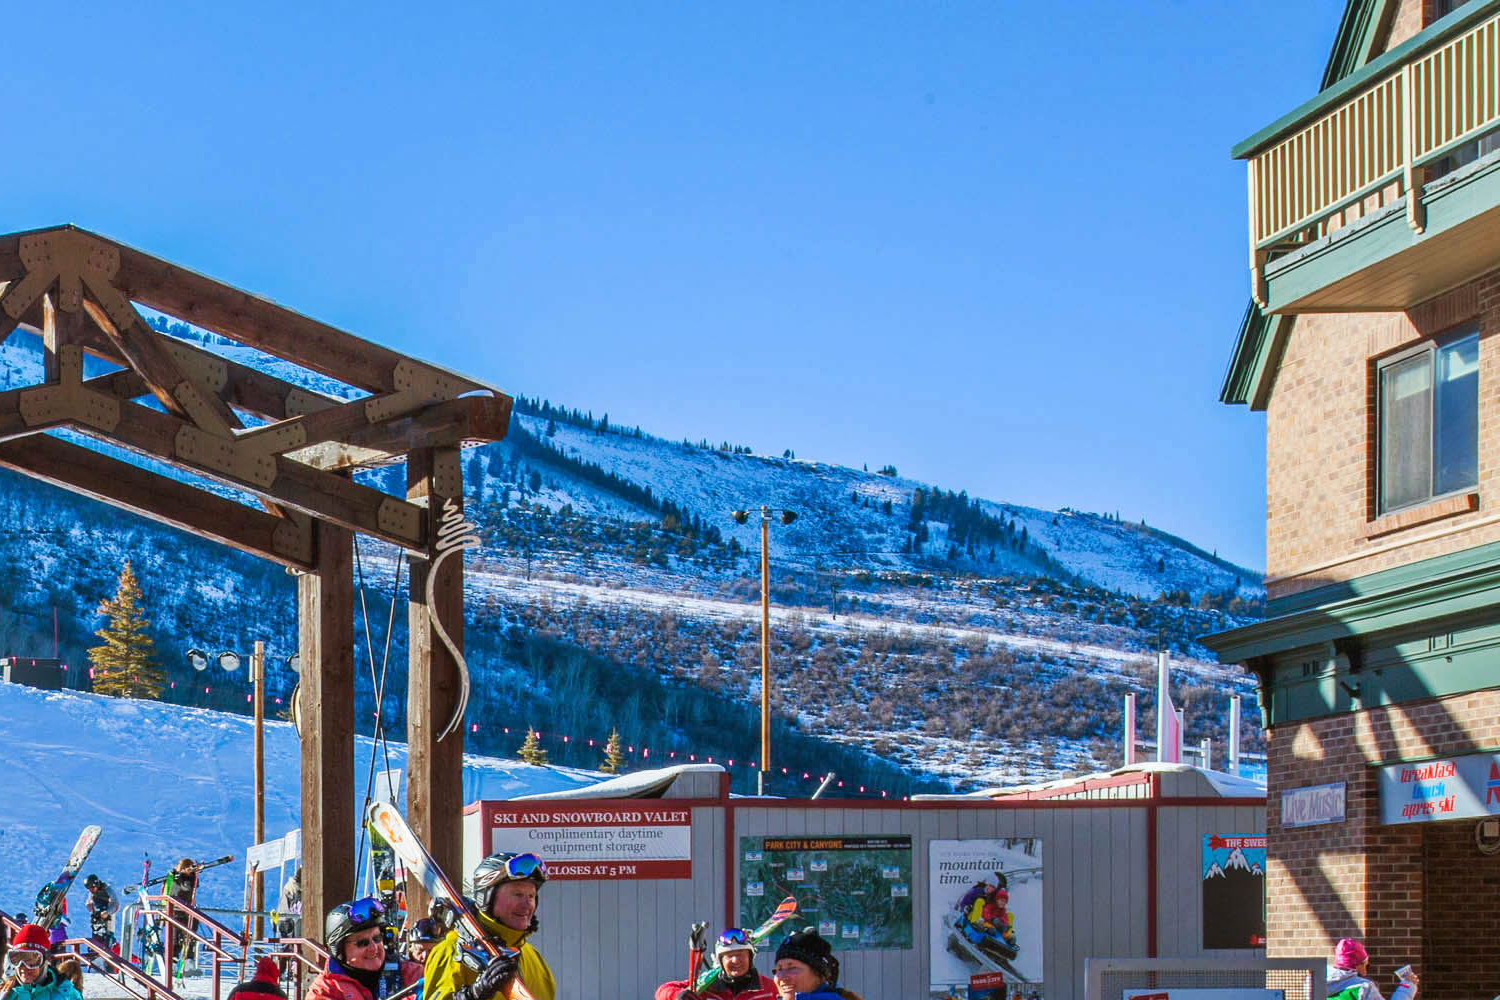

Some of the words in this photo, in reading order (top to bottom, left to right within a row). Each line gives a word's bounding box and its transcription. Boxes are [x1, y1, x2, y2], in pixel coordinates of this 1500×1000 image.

[1400, 760, 1457, 784] breakfast
[1284, 793, 1307, 822] Live
[1309, 788, 1342, 819] Music
[1438, 794, 1456, 813] ski
[494, 814, 517, 824] SKI
[520, 814, 549, 824] AND
[552, 812, 642, 824] SNOWBOARD
[644, 811, 688, 822] VALET
[528, 829, 617, 842] Complimentary
[618, 828, 663, 840] daytime
[542, 842, 603, 854] equipment
[605, 841, 646, 853] storage
[765, 840, 784, 849] PARK
[785, 840, 801, 849] CITY
[810, 840, 843, 849] CANYONS
[1225, 839, 1242, 848] THE
[939, 857, 1004, 870] mountain
[547, 866, 590, 876] CLOSES
[592, 866, 608, 875] AT
[609, 866, 617, 876] 5
[619, 866, 636, 875] PM
[939, 872, 972, 884] time.
